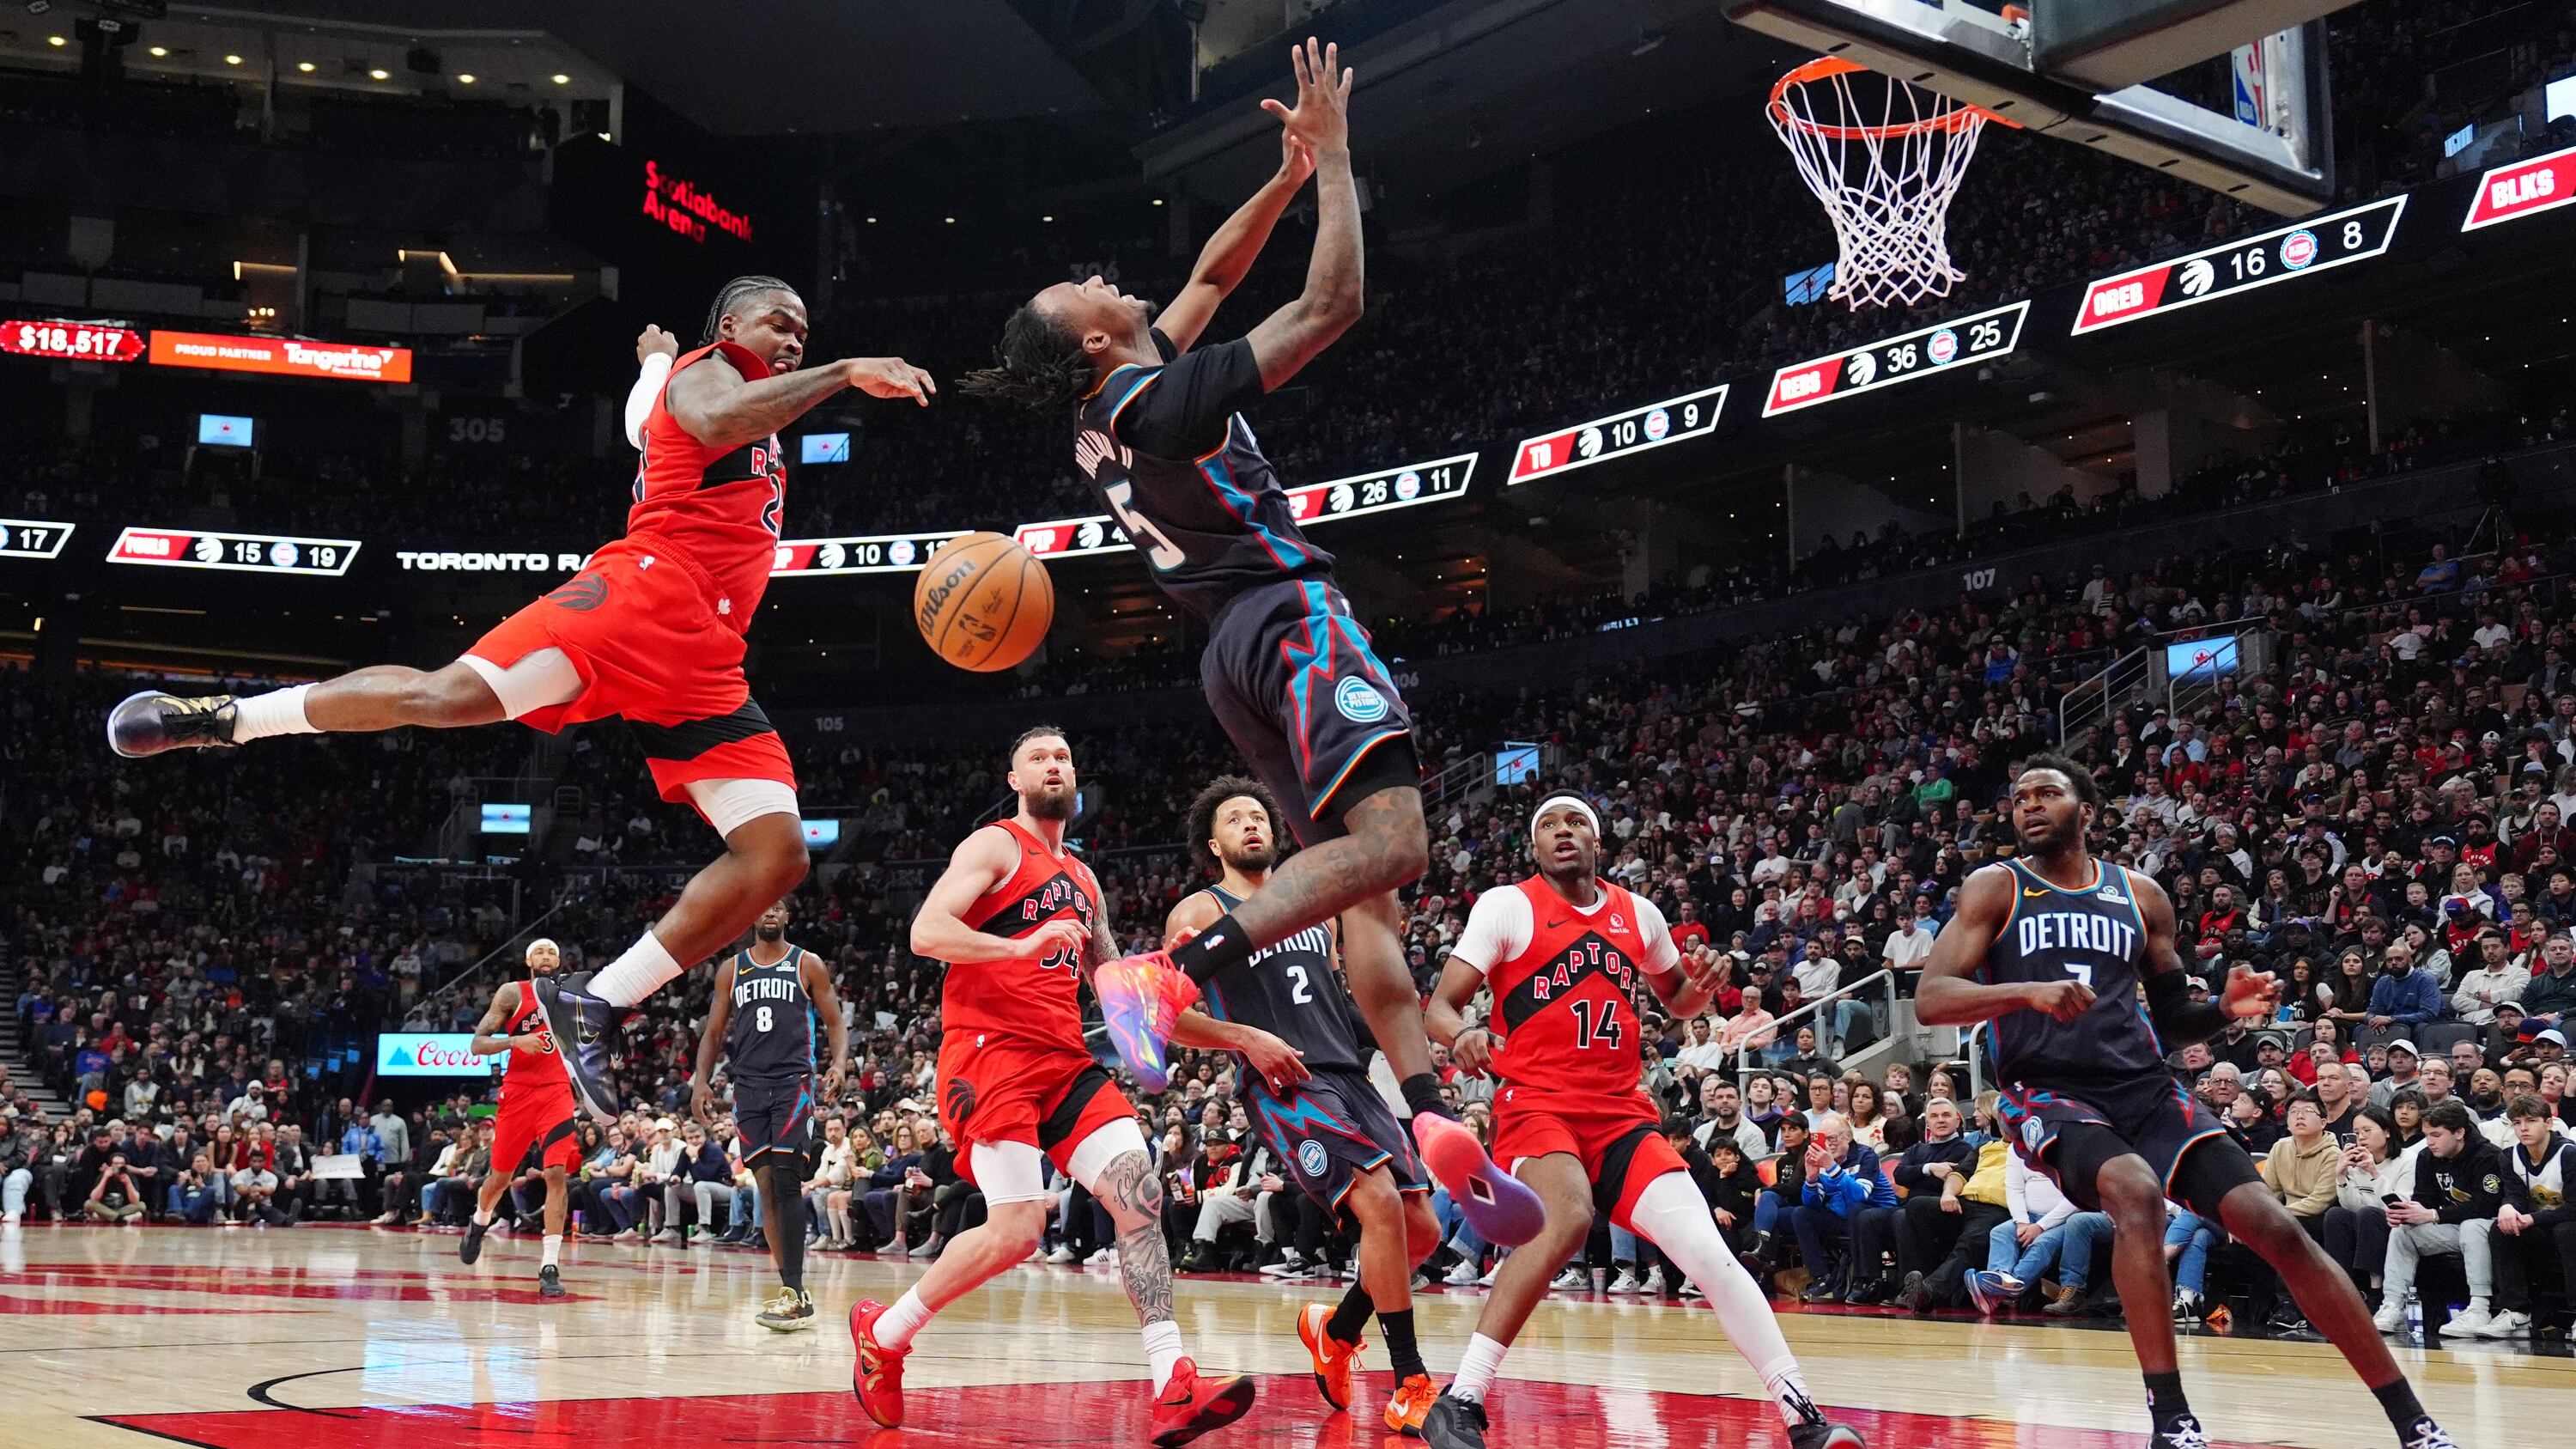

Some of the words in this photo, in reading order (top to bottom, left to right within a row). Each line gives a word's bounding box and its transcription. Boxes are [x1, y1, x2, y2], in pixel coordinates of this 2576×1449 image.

[646, 160, 754, 243] Scotiabank
[2491, 168, 2555, 208] BLKS
[643, 189, 705, 244] Arena
[2093, 282, 2143, 317] OREB
[2232, 247, 2266, 282] 16
[2343, 221, 2362, 252] 8
[19, 325, 122, 356] $18,517
[175, 344, 216, 357] PROUD
[218, 347, 271, 362] PARTNER
[283, 343, 383, 370] Tangerine
[1779, 370, 1821, 401] REBS
[1887, 344, 1917, 373] 36
[1970, 320, 2002, 352] 25
[449, 417, 505, 442] 305
[1612, 420, 1637, 447] 10
[1684, 404, 1698, 428] 9
[1363, 480, 1388, 505] 26
[1431, 467, 1451, 492] 11
[20, 528, 48, 550] 17
[1103, 478, 1187, 574] 5
[1111, 526, 1130, 542] 4
[234, 542, 261, 563] 15
[309, 546, 336, 567] 19
[396, 552, 550, 571] TORONTO
[856, 545, 880, 564] 10
[1963, 568, 1996, 591] 107
[920, 559, 976, 637] Wilson
[816, 716, 844, 731] 105
[1022, 880, 1095, 929] RAPTOR
[2019, 912, 2136, 962] DETROIT
[1286, 965, 1313, 1005] 2
[1534, 942, 1637, 1004] RAPTORS
[735, 977, 797, 1008] DETROIT
[756, 1006, 773, 1032] 8
[1570, 999, 1622, 1050] 14
[417, 1040, 482, 1067] Coors
[542, 1031, 556, 1055] 3
